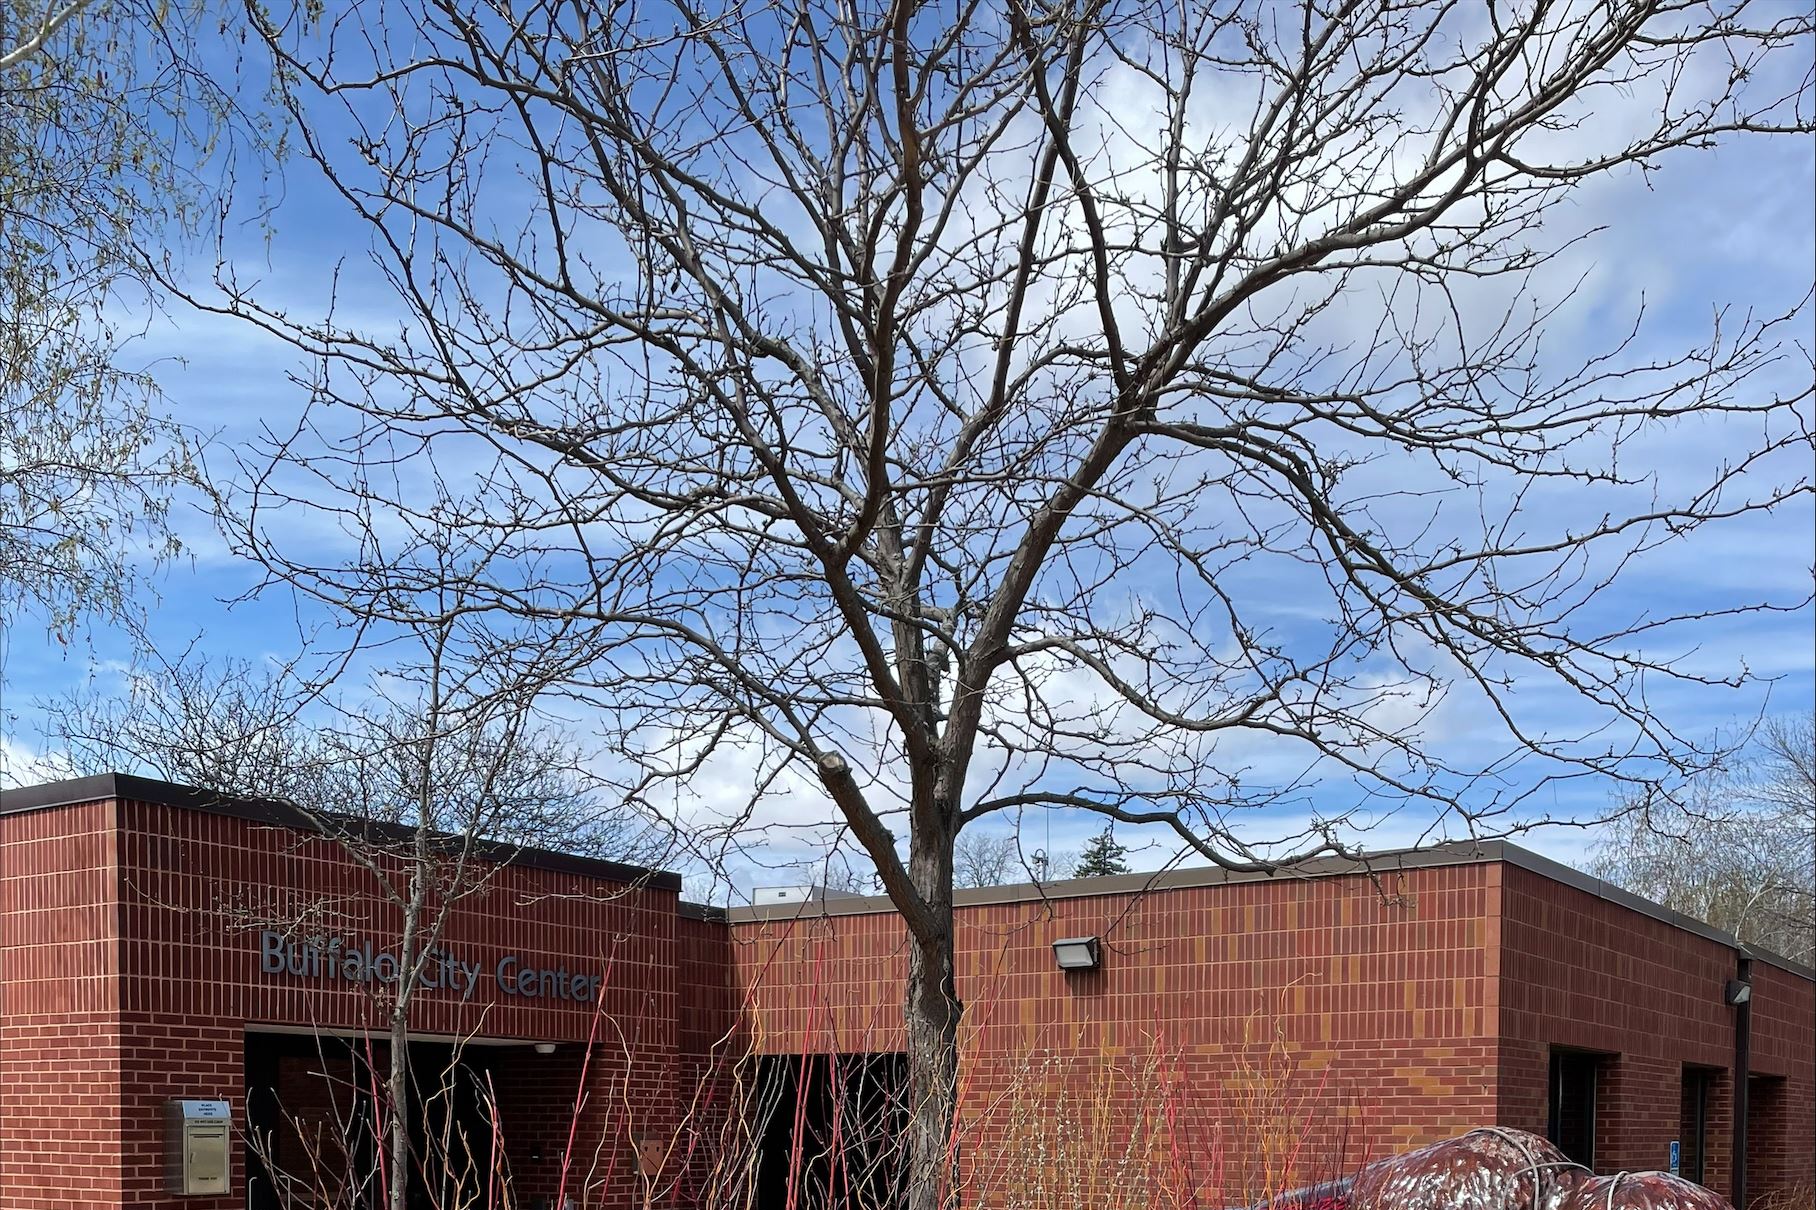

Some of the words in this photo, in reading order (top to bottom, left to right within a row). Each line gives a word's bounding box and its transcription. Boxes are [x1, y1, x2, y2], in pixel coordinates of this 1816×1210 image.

[262, 930, 399, 983] Buffalo
[416, 947, 481, 999] City
[497, 956, 601, 1002] Center
